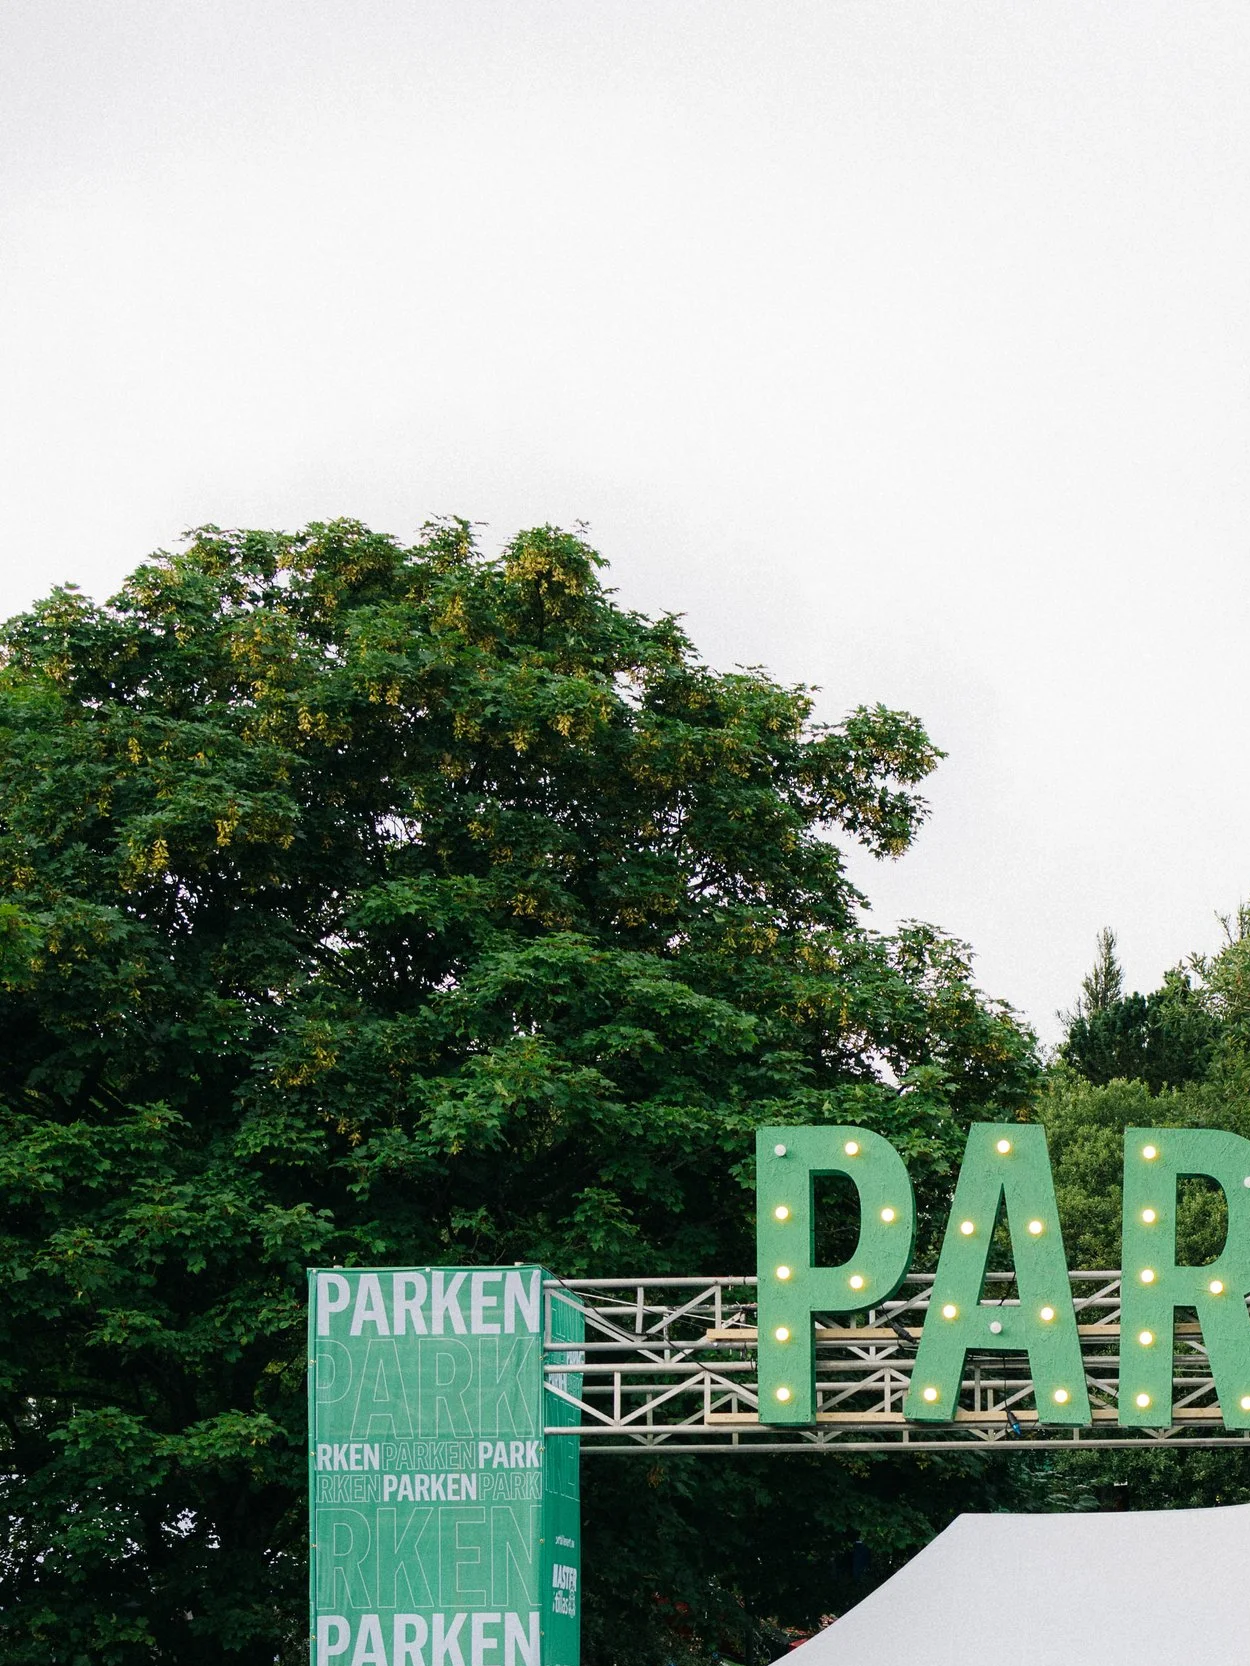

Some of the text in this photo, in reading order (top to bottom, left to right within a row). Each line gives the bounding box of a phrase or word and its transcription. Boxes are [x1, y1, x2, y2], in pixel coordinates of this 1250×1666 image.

[316, 1269, 541, 1336] PARKEN
[315, 1337, 542, 1441] PARK
[315, 1440, 543, 1471] RKEN PARKEN PARK
[383, 1473, 477, 1502] PARKEN
